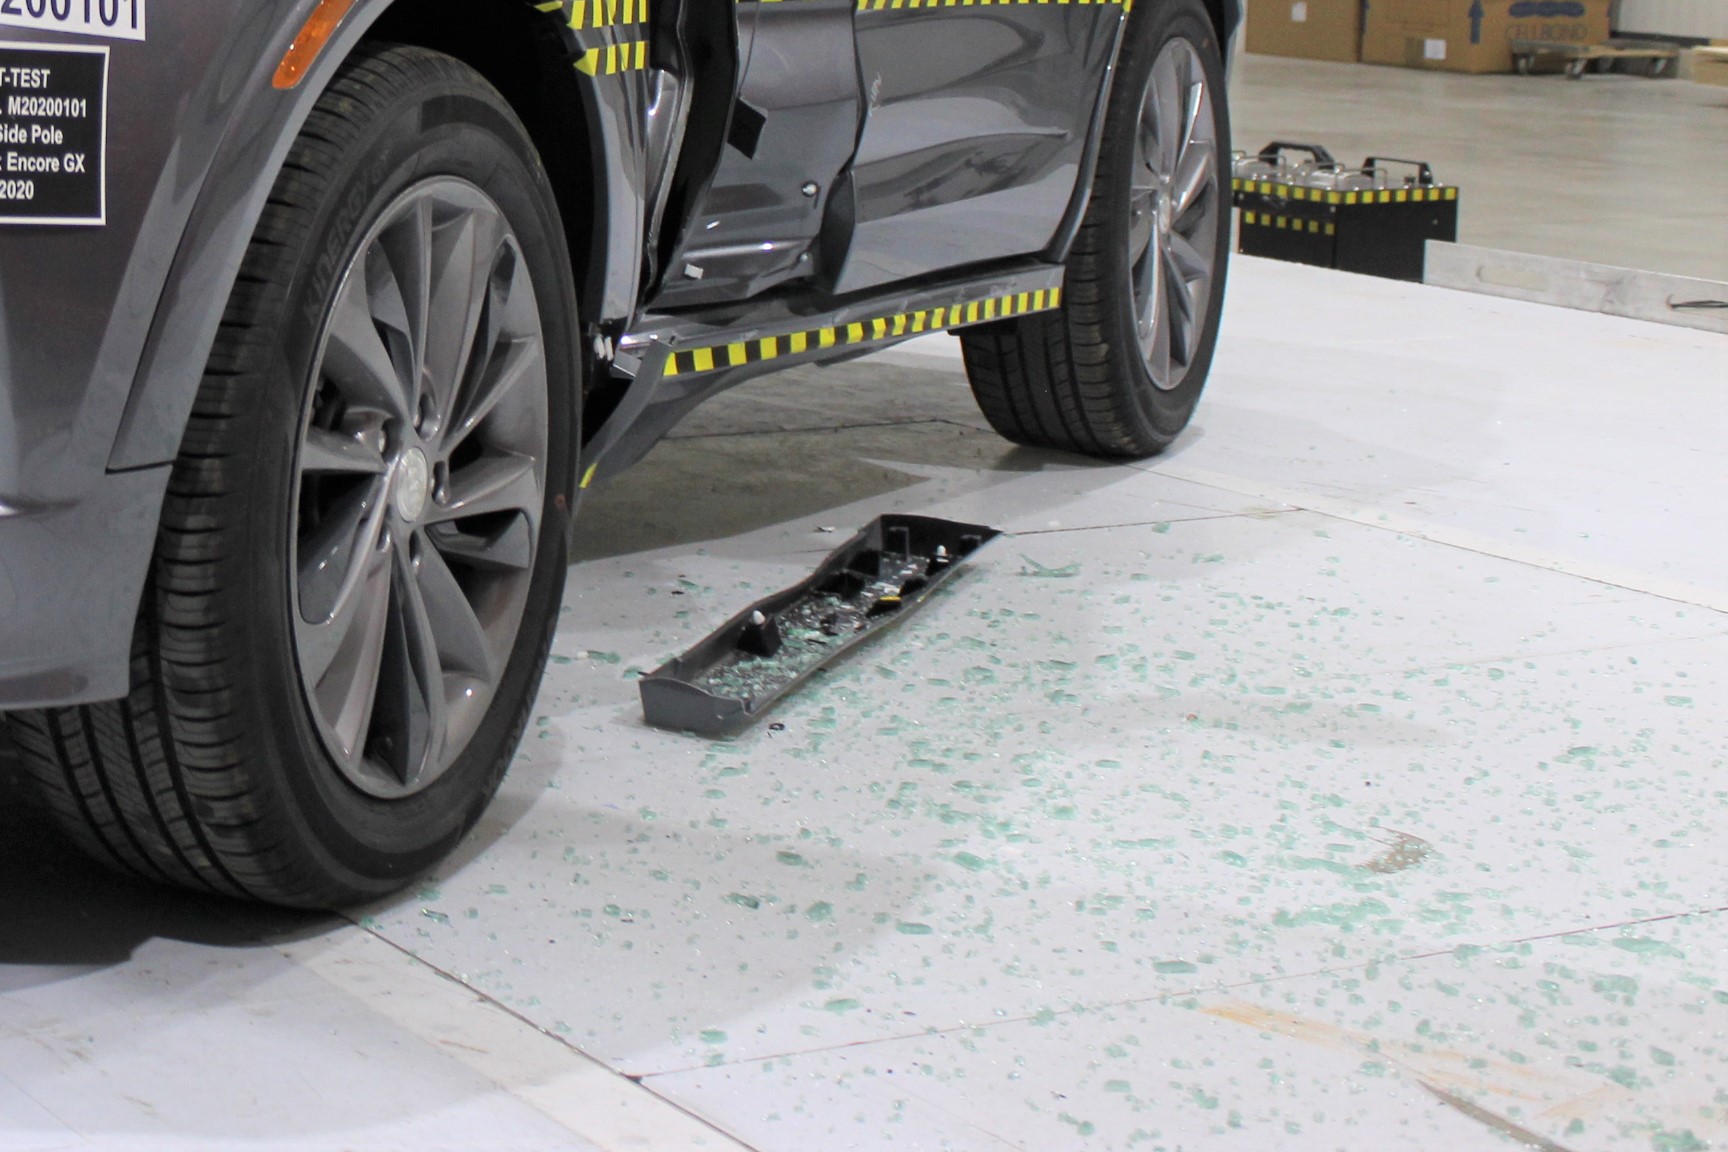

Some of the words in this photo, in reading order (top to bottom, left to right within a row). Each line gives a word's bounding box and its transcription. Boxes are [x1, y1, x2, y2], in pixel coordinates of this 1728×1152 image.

[8, 96, 88, 118] M20200101
[31, 124, 64, 145] Pole
[6, 151, 60, 172] Encore
[63, 153, 86, 173] GX
